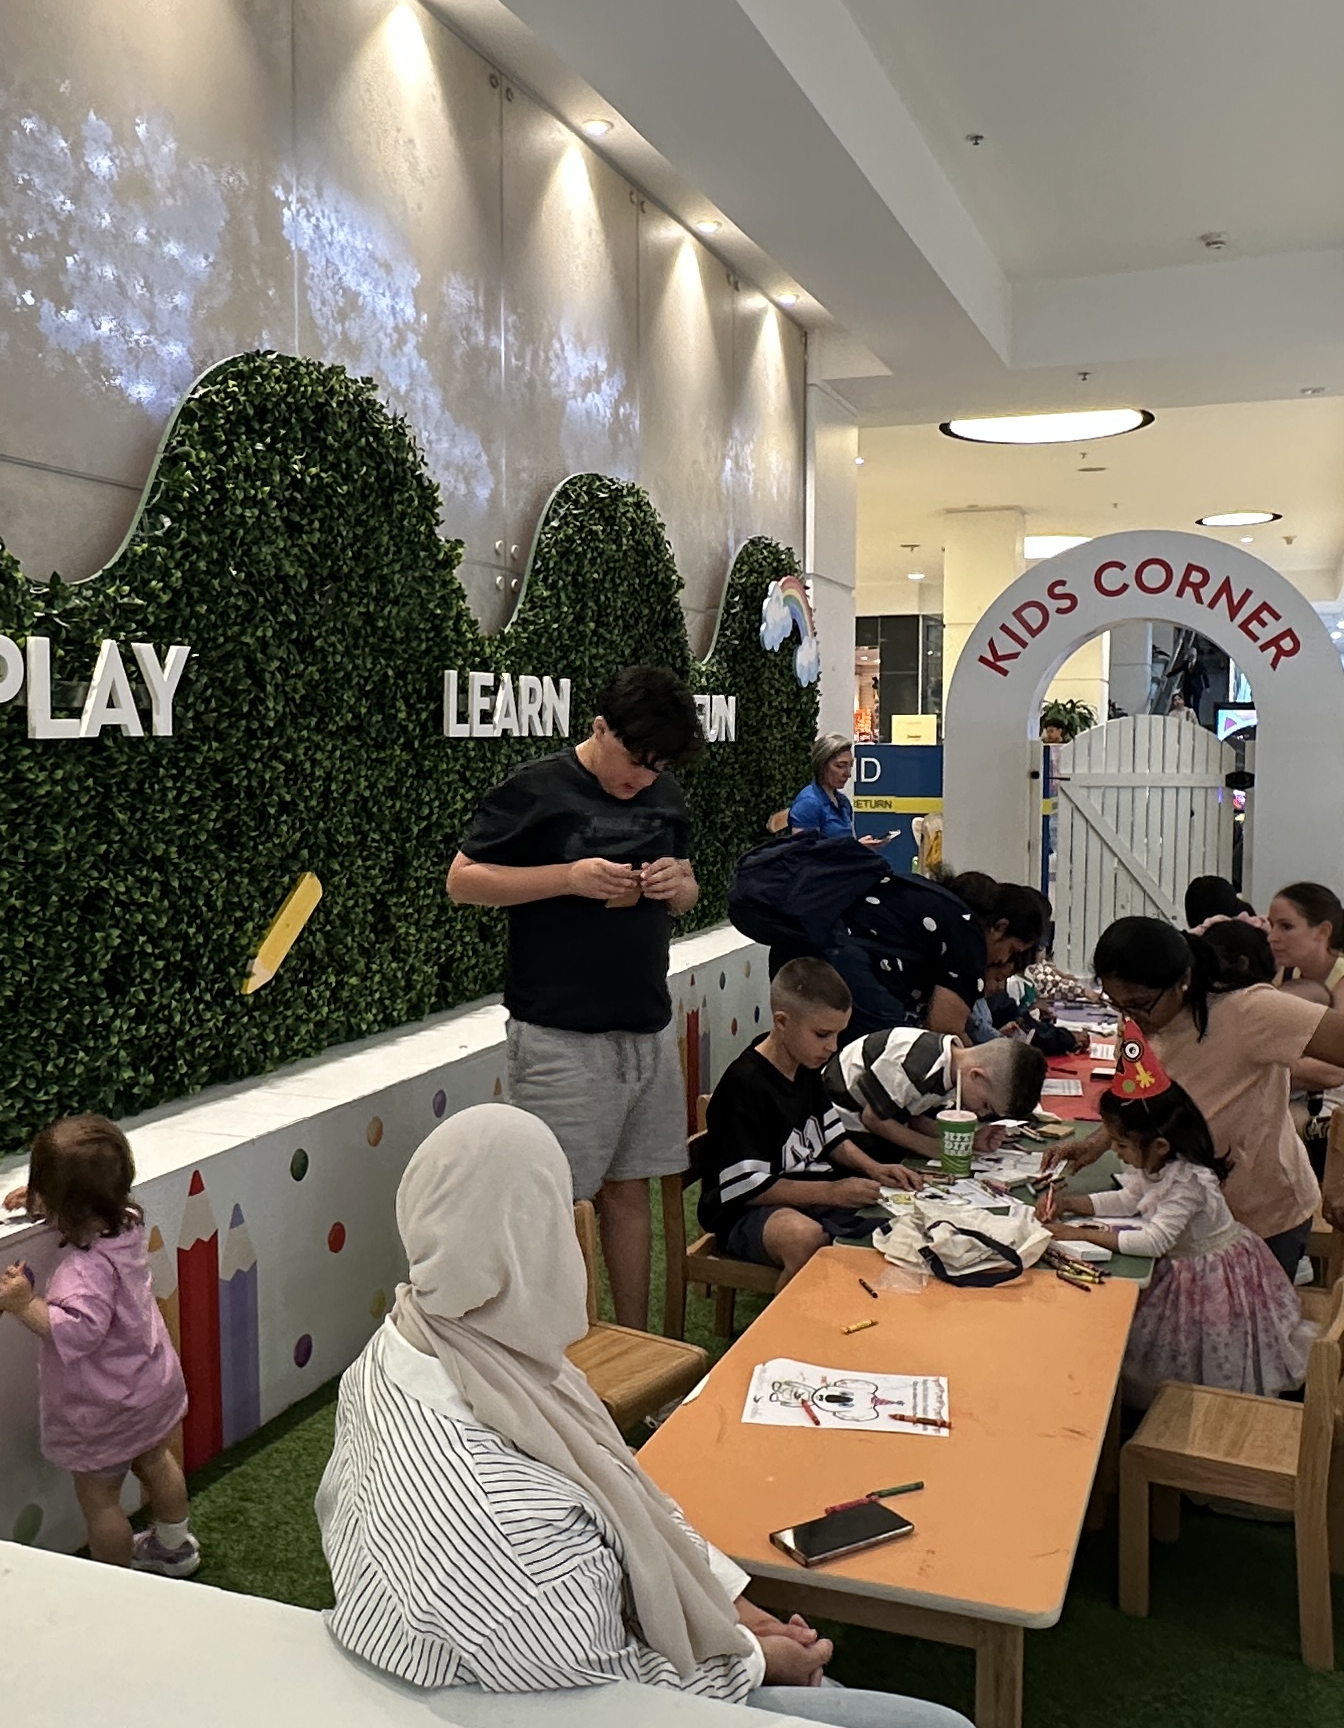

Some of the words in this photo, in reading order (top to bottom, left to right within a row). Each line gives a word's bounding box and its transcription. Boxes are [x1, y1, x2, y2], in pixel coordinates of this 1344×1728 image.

[977, 579, 1079, 678] KIDS
[1094, 557, 1301, 672] CORNER
[443, 669, 571, 738] LEARN
